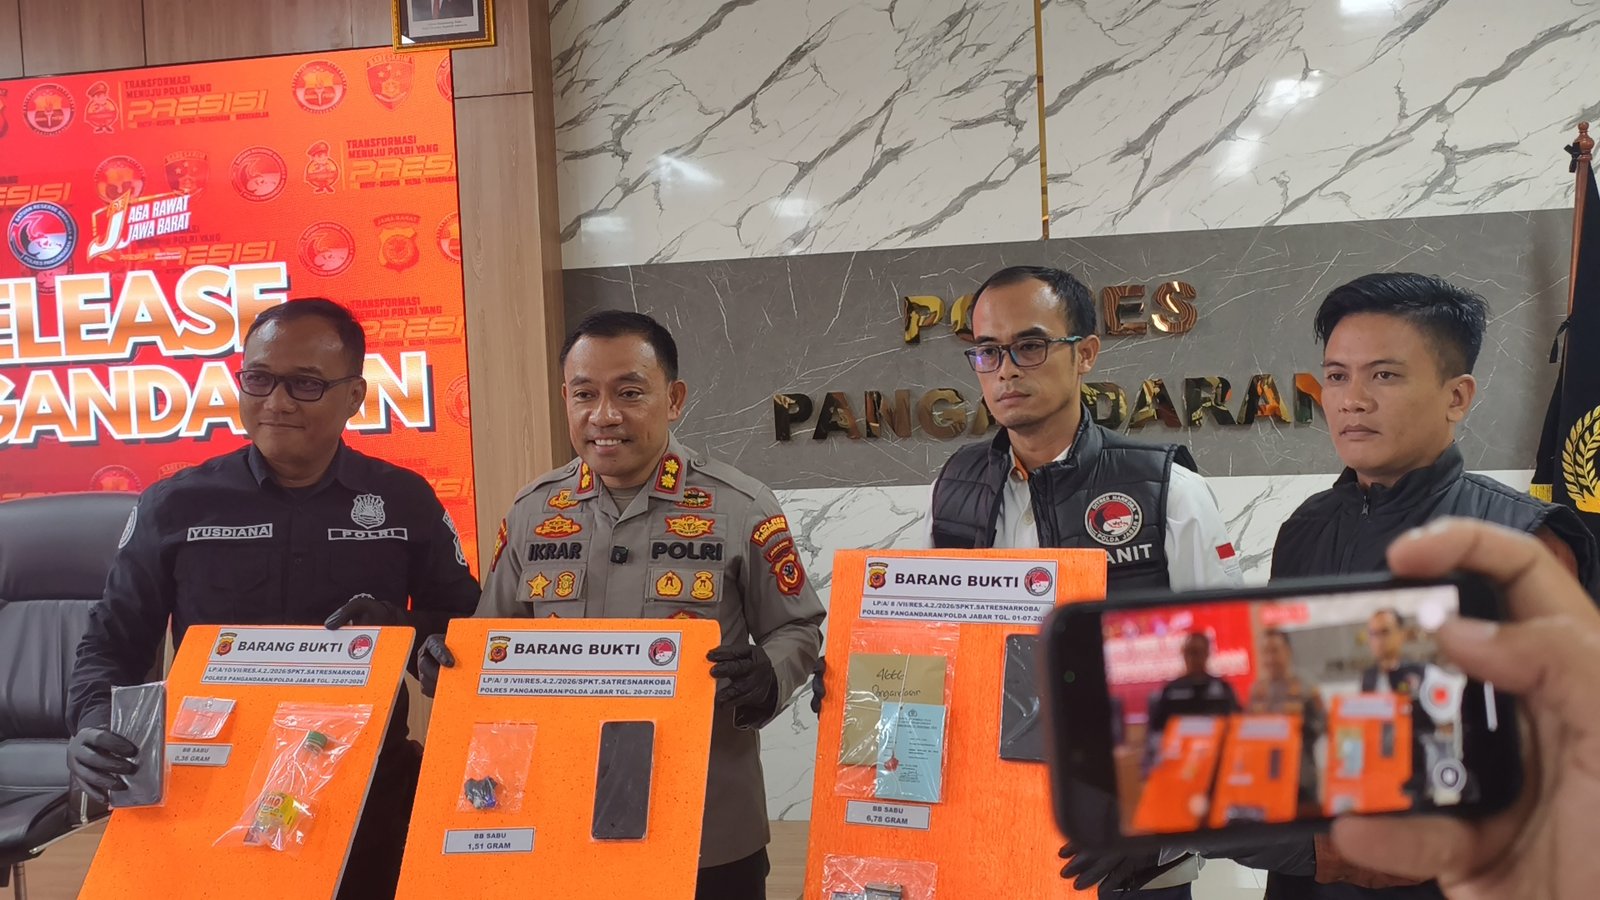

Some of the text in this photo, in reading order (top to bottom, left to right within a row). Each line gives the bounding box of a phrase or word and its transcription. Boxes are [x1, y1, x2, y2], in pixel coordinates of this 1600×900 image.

[125, 75, 190, 89] TRANSFORMASI
[164, 85, 188, 96] POLRI
[191, 84, 212, 93] YANG
[128, 90, 268, 120] PRESISI
[346, 135, 416, 149] TRANSFORMASI
[348, 144, 438, 158] MENUJU POLRI YANG
[152, 195, 190, 218] RAWAT
[116, 212, 192, 249] JAWA BARAT
[192, 526, 269, 538] YUSDIANA
[342, 529, 395, 539] POLRI
[528, 542, 583, 562] IKRAR
[652, 541, 723, 561] POLRI
[895, 573, 1019, 588] BARANG BUKTI
[968, 612, 992, 620] JABAR
[237, 641, 343, 653] BARANG BUKTI
[514, 643, 641, 655] BARANG BUKTI
[883, 806, 904, 814] SABU
[866, 815, 909, 825] 6,78 GRAM
[468, 842, 511, 851] 1,51 GRAM
